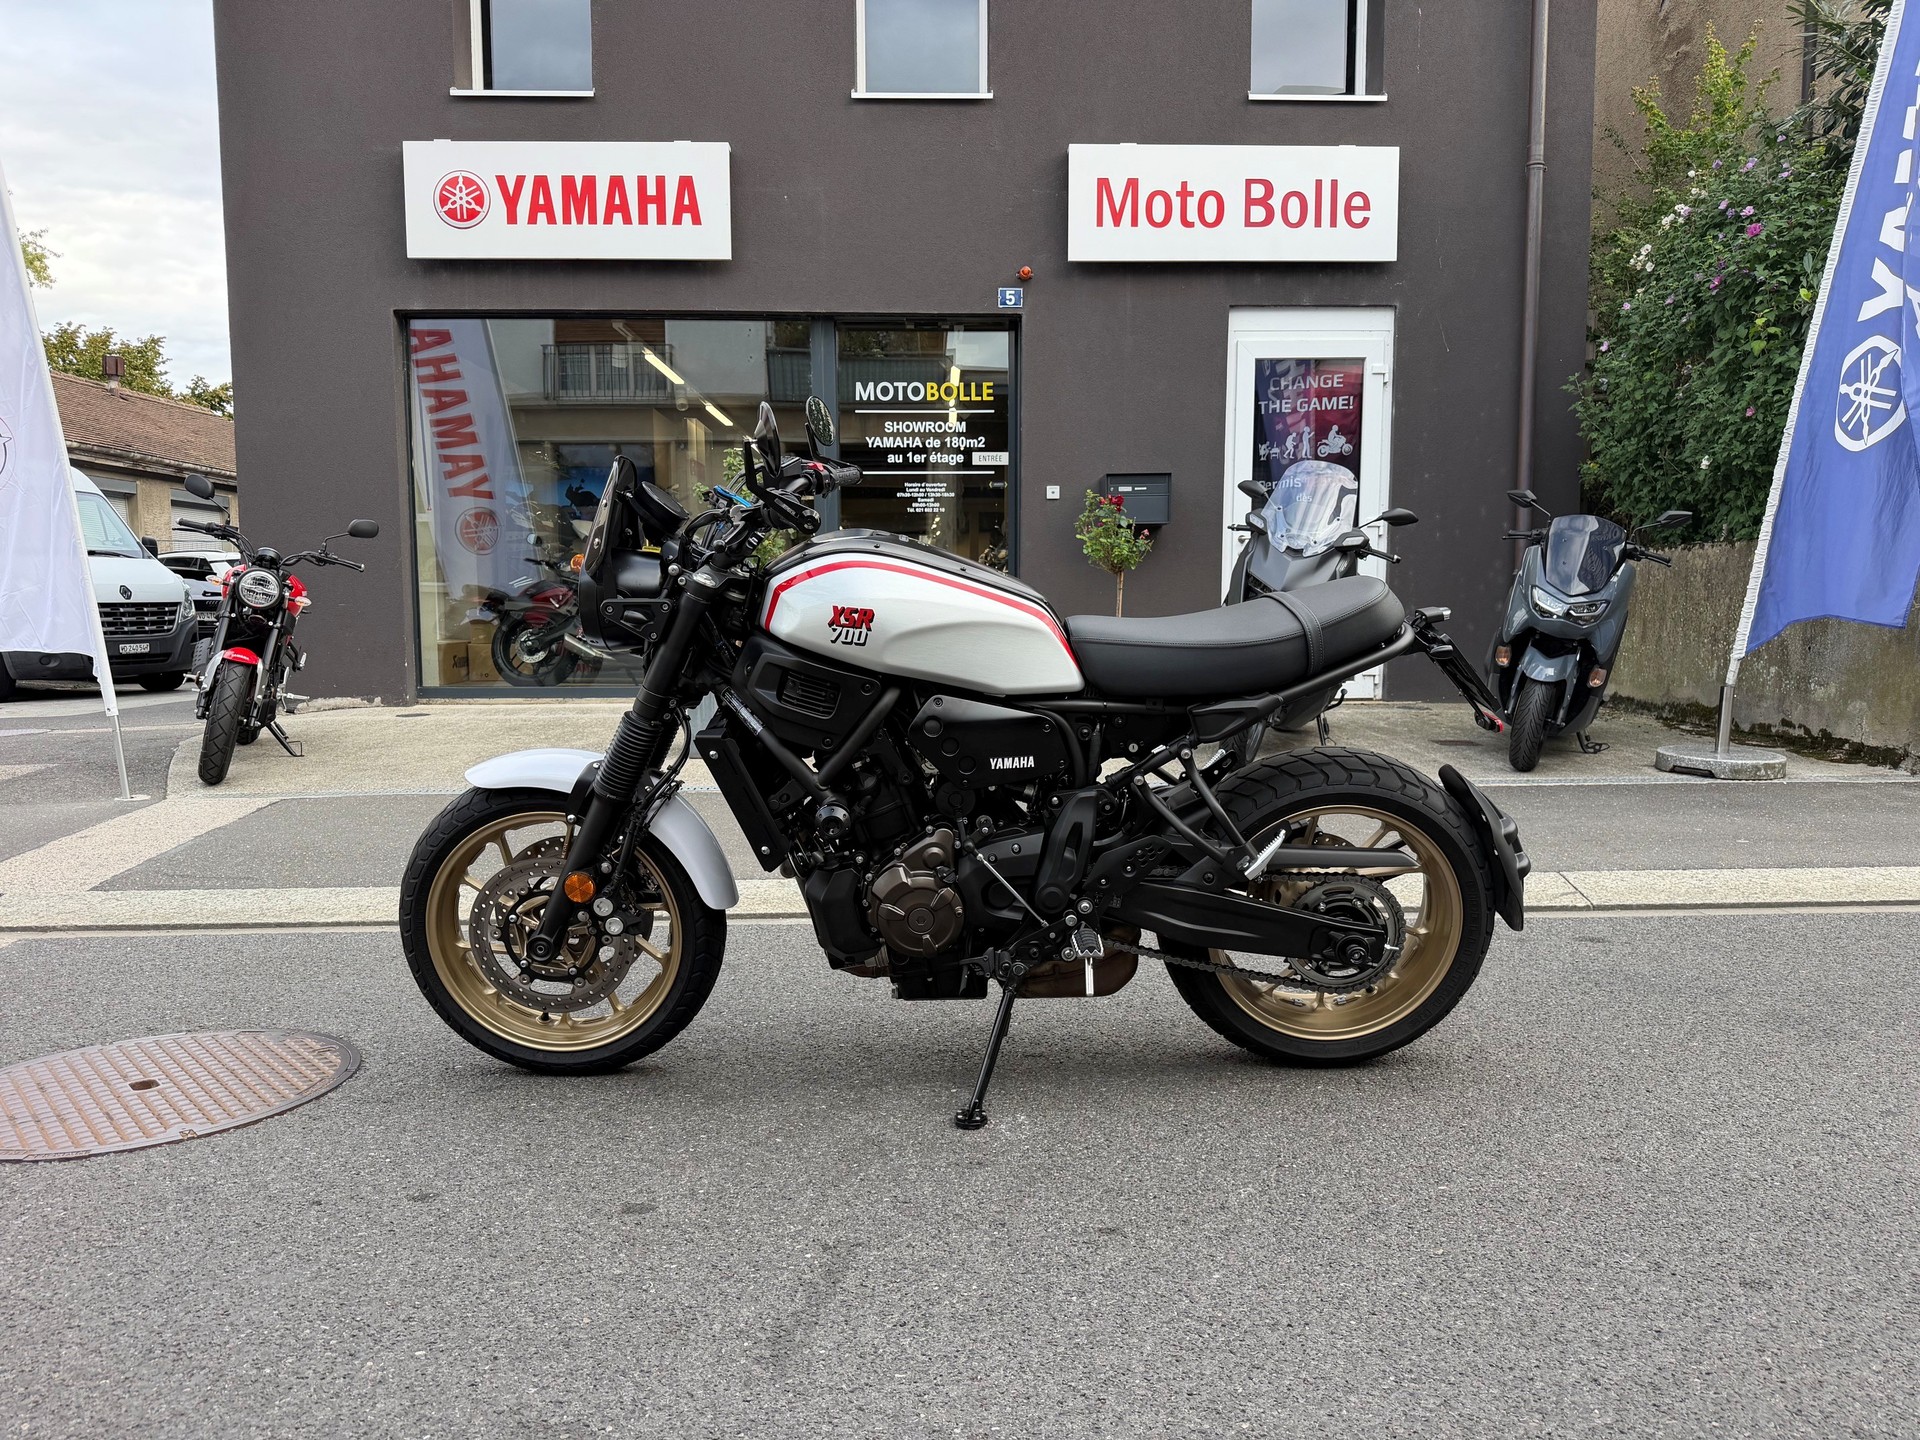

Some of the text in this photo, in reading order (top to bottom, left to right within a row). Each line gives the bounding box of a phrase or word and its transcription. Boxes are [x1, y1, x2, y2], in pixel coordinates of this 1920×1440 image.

[495, 174, 703, 226] YAMAHA
[1095, 177, 1371, 229] Moto Bolle
[1005, 290, 1016, 306] 5
[1270, 373, 1344, 391] CHANGE
[1258, 395, 1354, 415] THE GAME!
[884, 421, 967, 433] SHOWROOM
[865, 436, 986, 448] YAMAHA de 180m2
[887, 452, 964, 466] au 1er étage
[978, 454, 1003, 462] ENTRÉE
[1296, 493, 1313, 502] dès
[828, 604, 876, 632] XSR
[829, 626, 869, 647] 700
[989, 756, 1035, 770] YAMAHA
